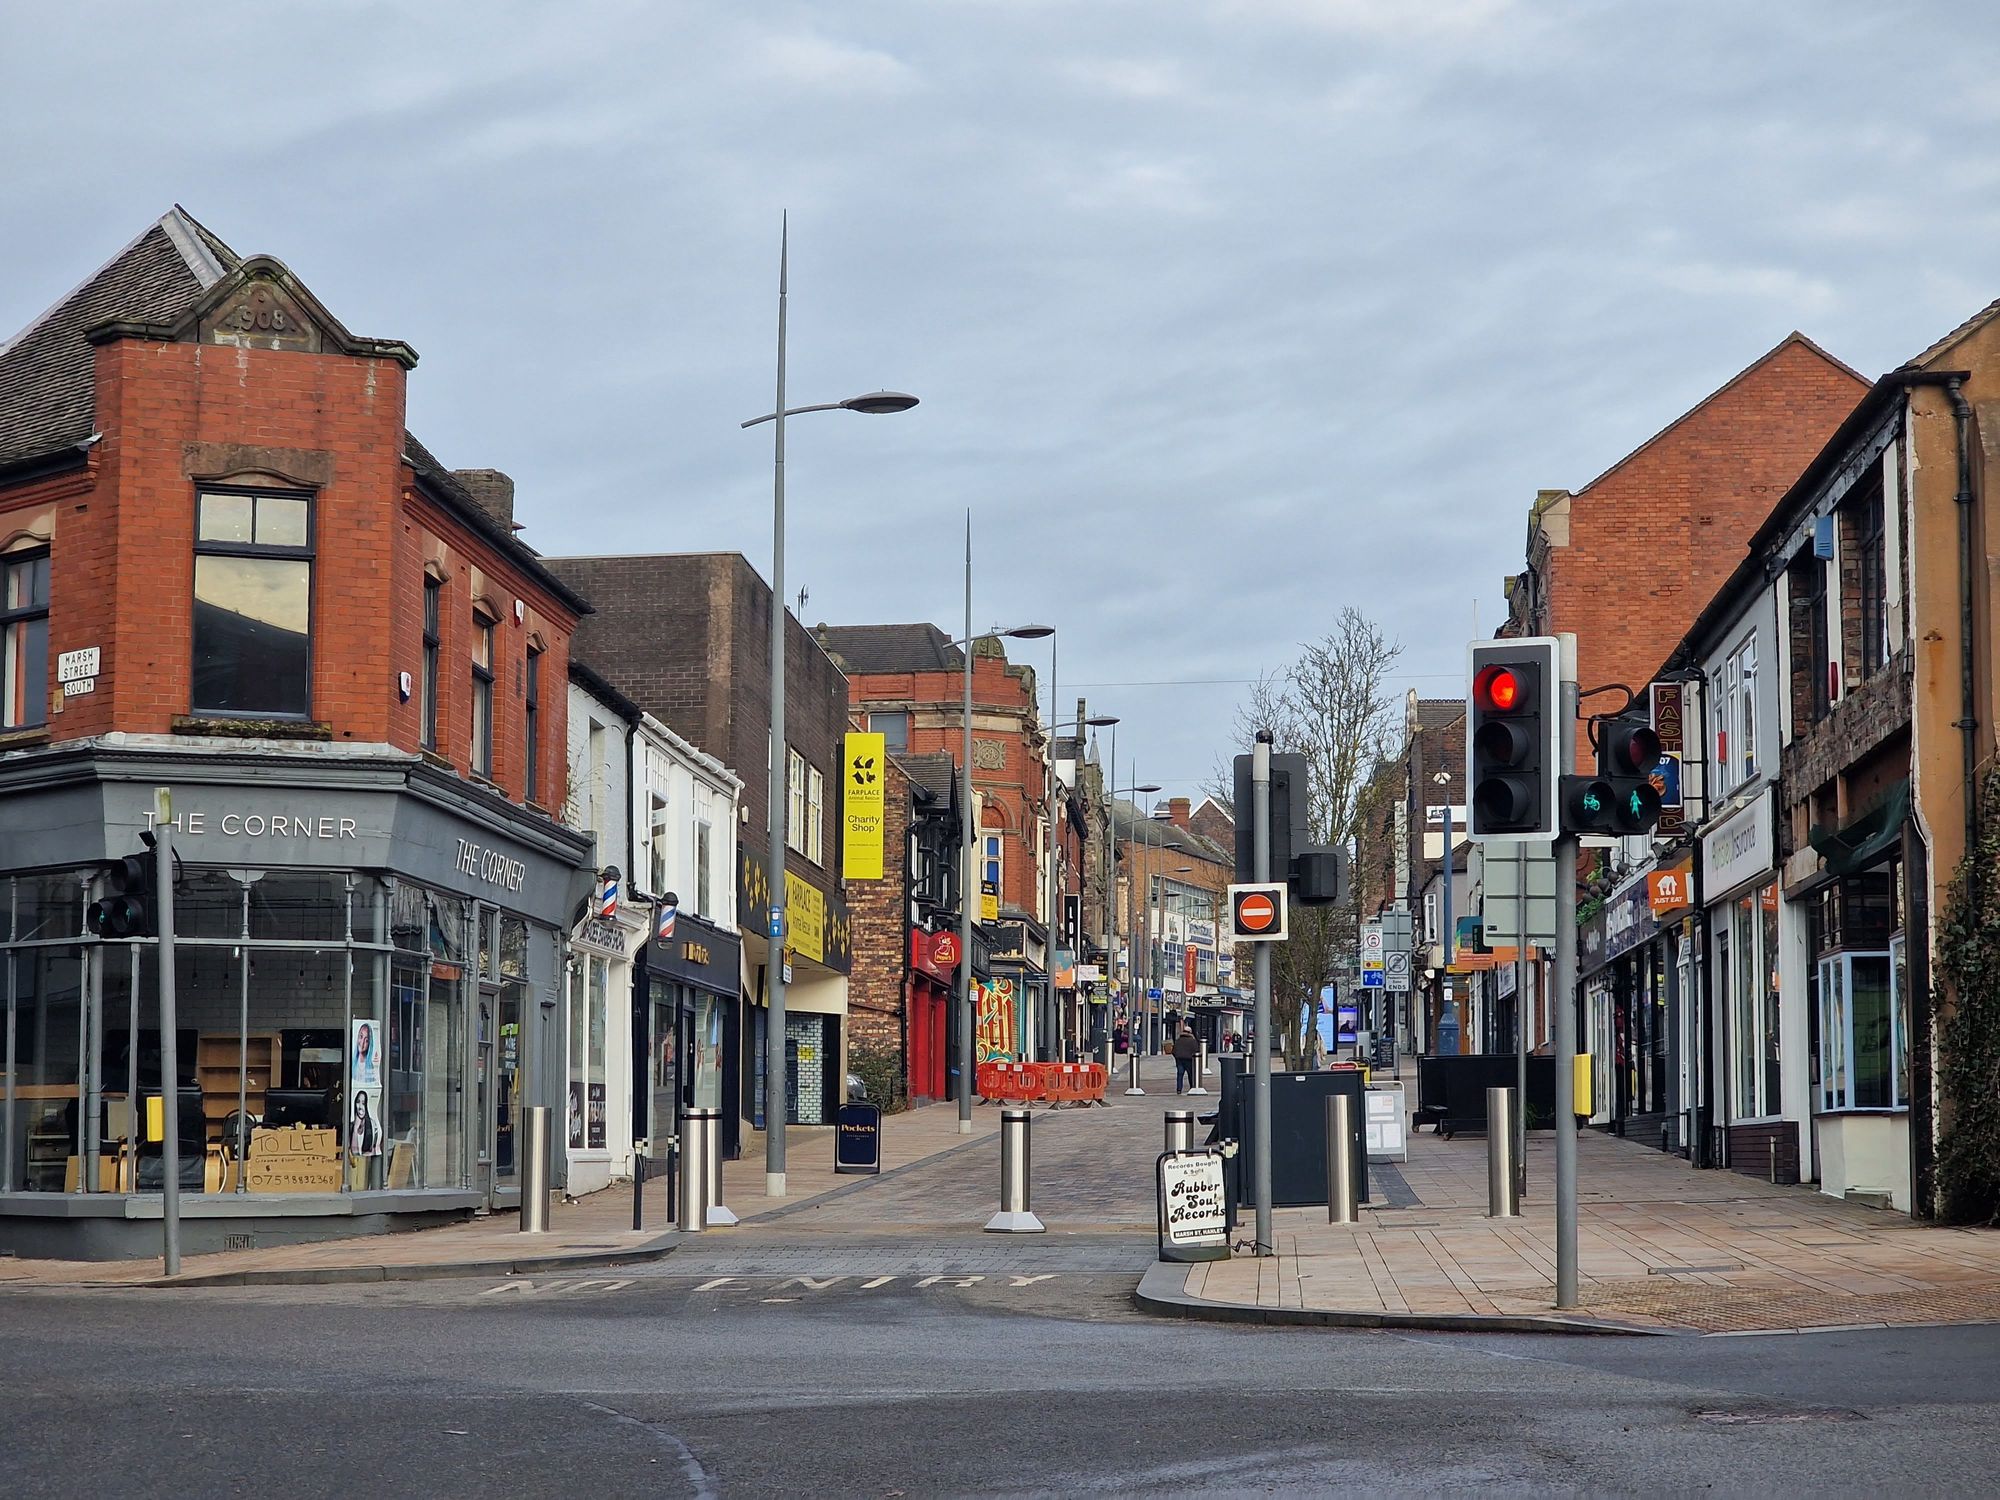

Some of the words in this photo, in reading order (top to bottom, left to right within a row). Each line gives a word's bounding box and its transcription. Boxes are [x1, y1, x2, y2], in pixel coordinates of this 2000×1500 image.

[65, 650, 93, 665] MARSH
[63, 663, 94, 679] STREET
[66, 680, 92, 695] SOUTH
[1658, 688, 1682, 752] FAST
[142, 811, 205, 834] THE
[221, 814, 357, 839] CORNER
[847, 815, 880, 825] Charity
[851, 824, 875, 834] Shop
[455, 838, 480, 876] THE
[480, 848, 526, 893] CORNER
[1654, 897, 1669, 905] JUST
[841, 1124, 876, 1132] Pockets
[254, 1134, 279, 1153] TO
[290, 1132, 328, 1151] LET
[1195, 1160, 1218, 1168] Bought
[1170, 1180, 1221, 1198] Rubber
[1169, 1205, 1227, 1224] Records
[1175, 1230, 1194, 1238] MARSH
[1203, 1226, 1224, 1235] HANLEY
